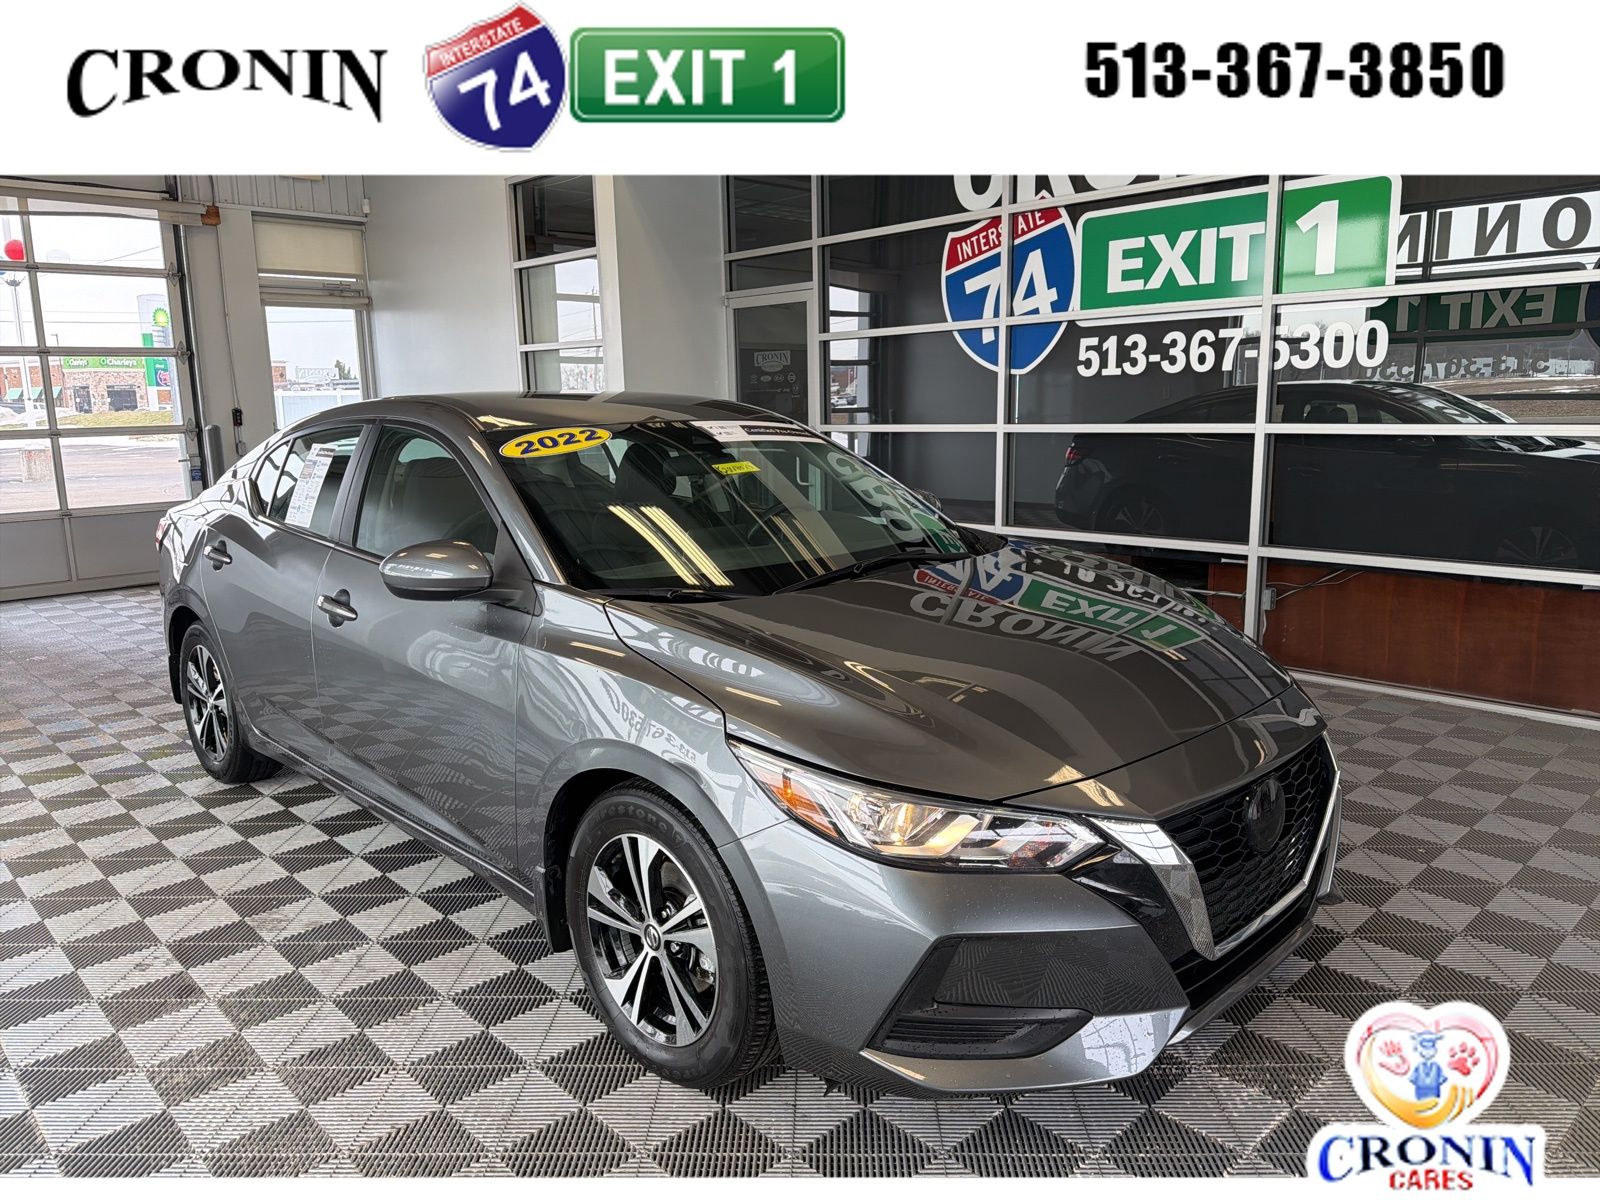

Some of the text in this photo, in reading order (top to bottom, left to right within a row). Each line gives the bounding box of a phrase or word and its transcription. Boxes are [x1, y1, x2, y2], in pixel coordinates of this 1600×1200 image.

[957, 208, 1047, 263] INTERSATE
[1106, 199, 1340, 294] EXIT 1
[963, 247, 1059, 345] 74
[107, 358, 137, 367] Charleys
[1076, 319, 1390, 378] 513-367-5300
[514, 429, 605, 456] 2022
